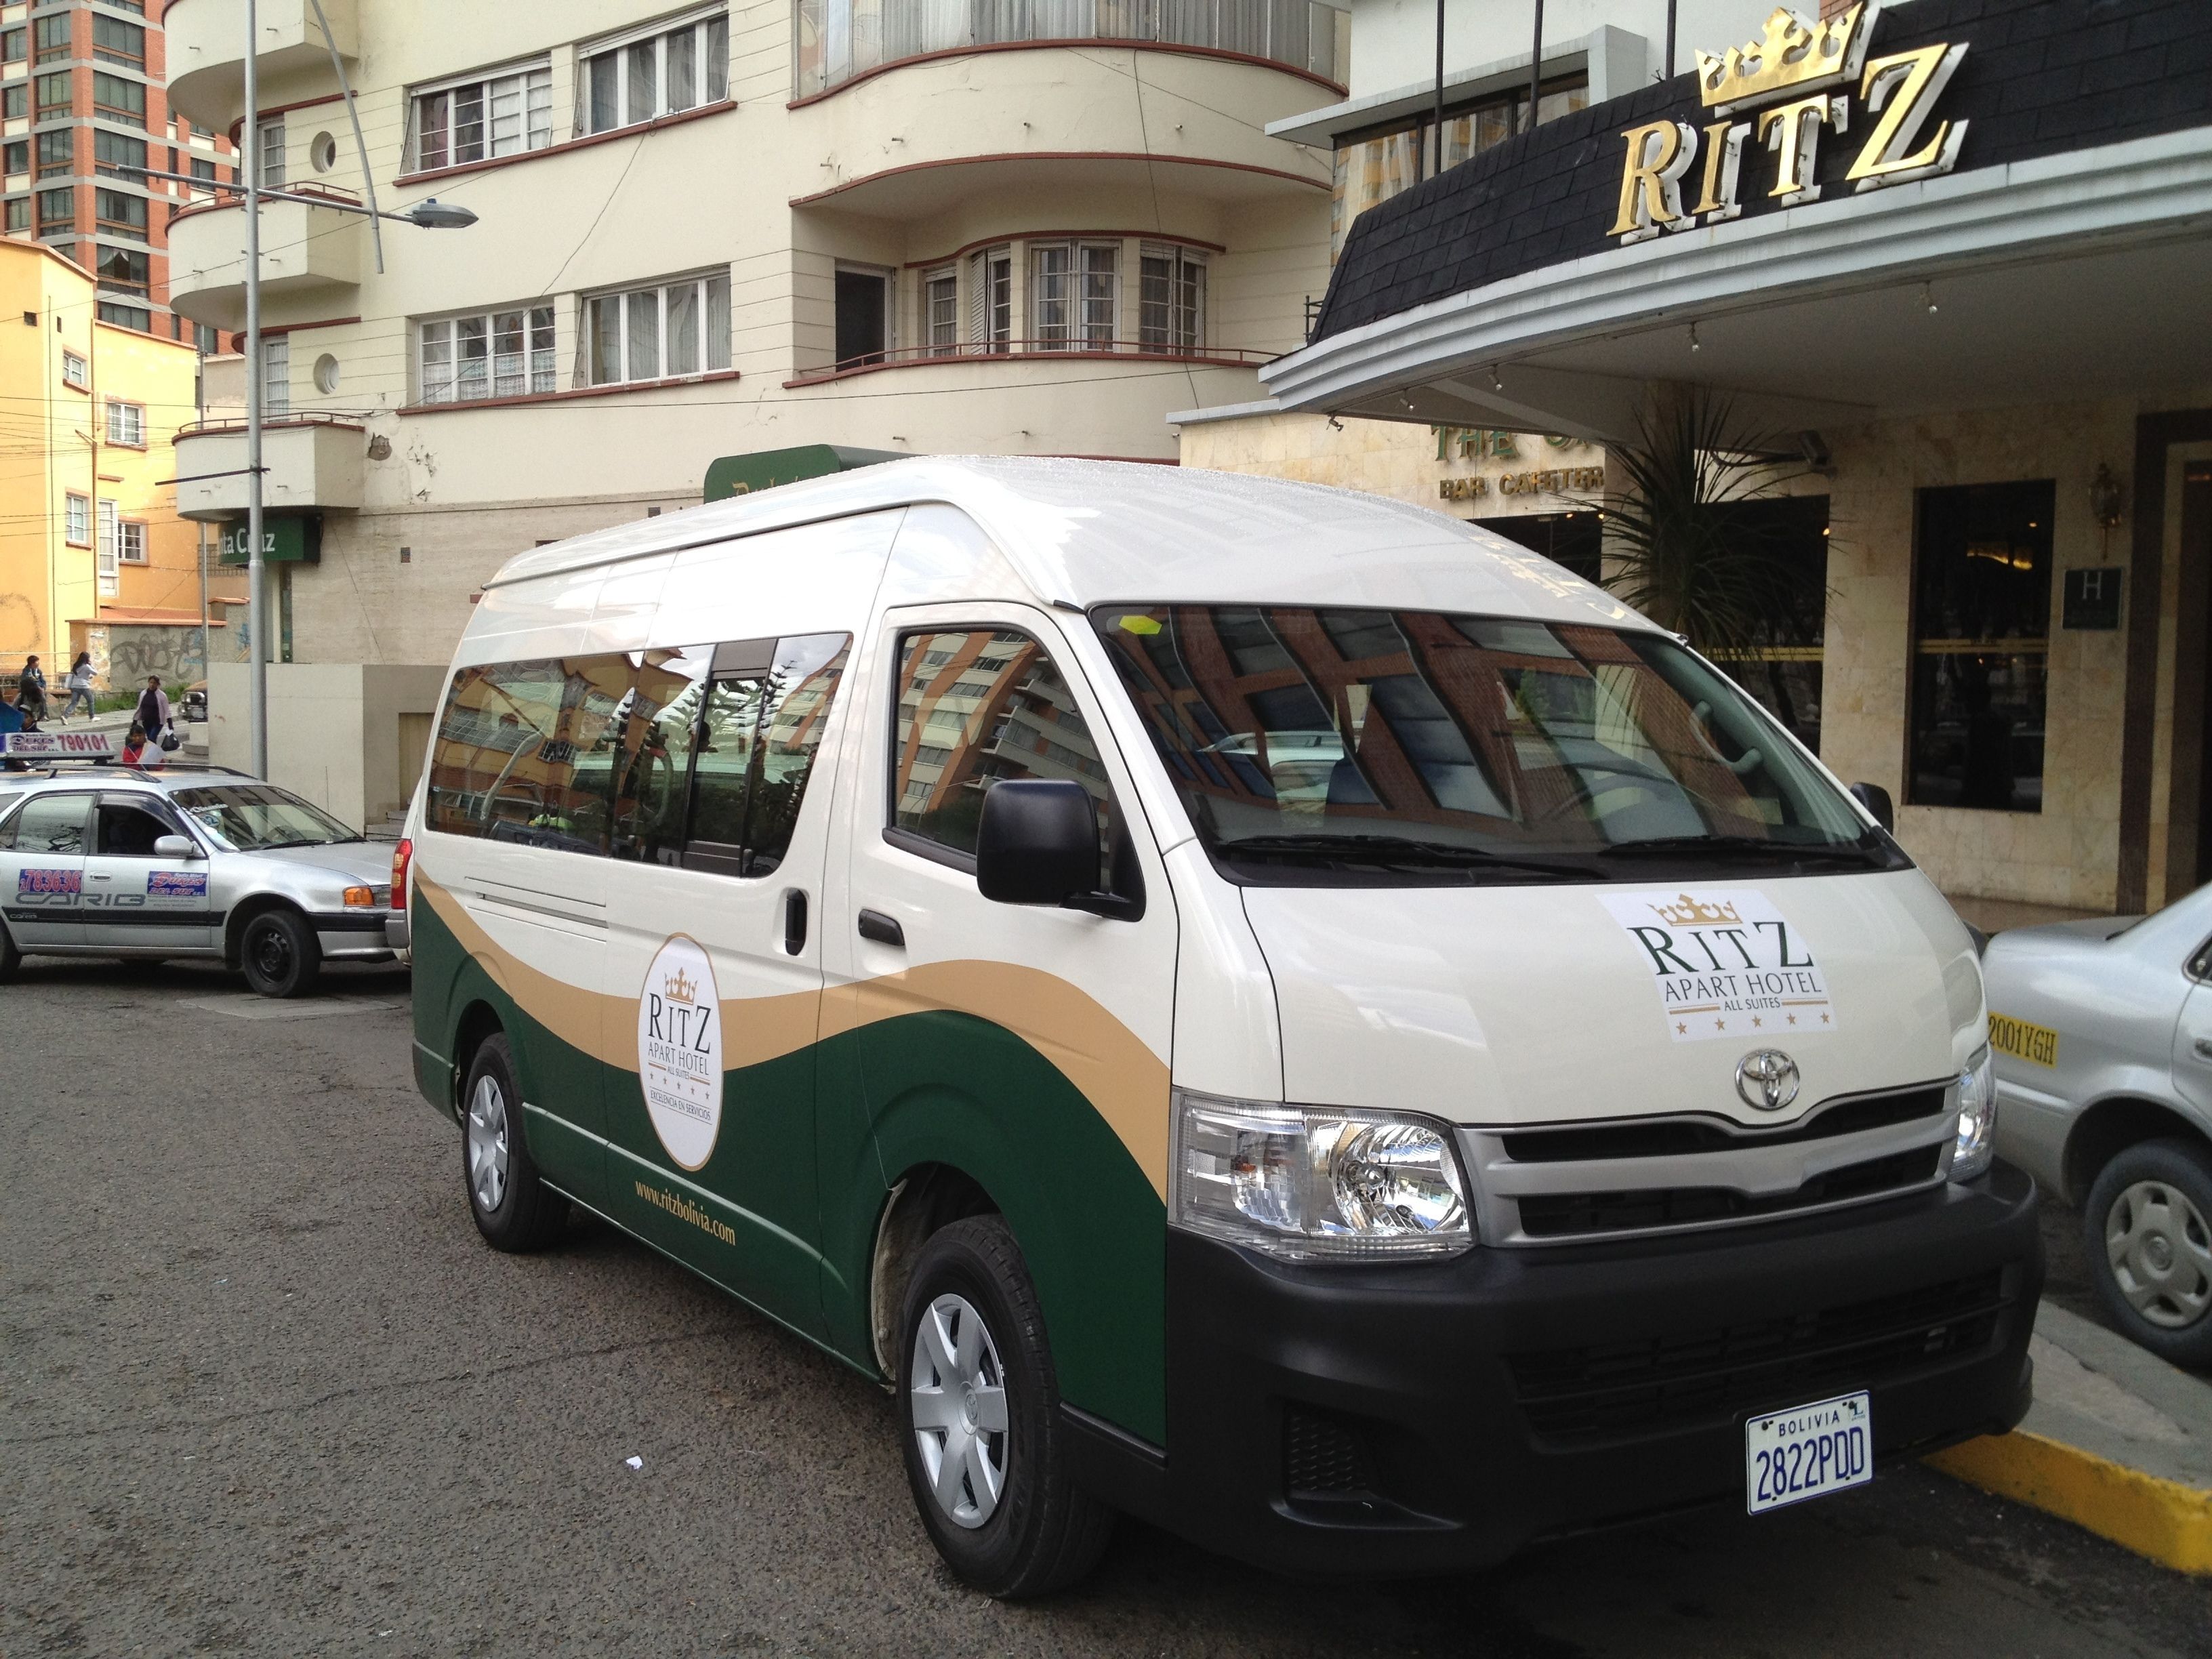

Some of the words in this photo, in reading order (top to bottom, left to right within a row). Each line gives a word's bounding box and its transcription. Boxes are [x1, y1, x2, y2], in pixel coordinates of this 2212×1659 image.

[1606, 42, 1964, 241] RITZ
[1430, 425, 1519, 462] THE
[1439, 477, 1486, 500] BAR
[2083, 571, 2102, 600] H
[56, 734, 109, 751] 790101
[16, 893, 146, 906] CARIB
[1627, 922, 1814, 976] RITZ
[1665, 976, 1739, 1002] APART
[1746, 972, 1822, 995] HOTEL
[1724, 999, 1744, 1012] ALL
[1746, 997, 1781, 1010] SUITES
[648, 993, 712, 1055] RITZ
[1988, 1016, 2056, 1065] 2001YGH
[648, 1041, 676, 1065] APART
[678, 1050, 710, 1076] HOTEL
[676, 1067, 690, 1080] SUITES
[651, 1090, 678, 1108] EXCELENCIA
[678, 1100, 686, 1111] EN
[686, 1103, 712, 1122] SERVICIOS
[635, 1180, 736, 1246] www.ritzbolivia.com
[1778, 1410, 1840, 1437] BOLIVIA
[1756, 1426, 1864, 1502] 2822PDD
